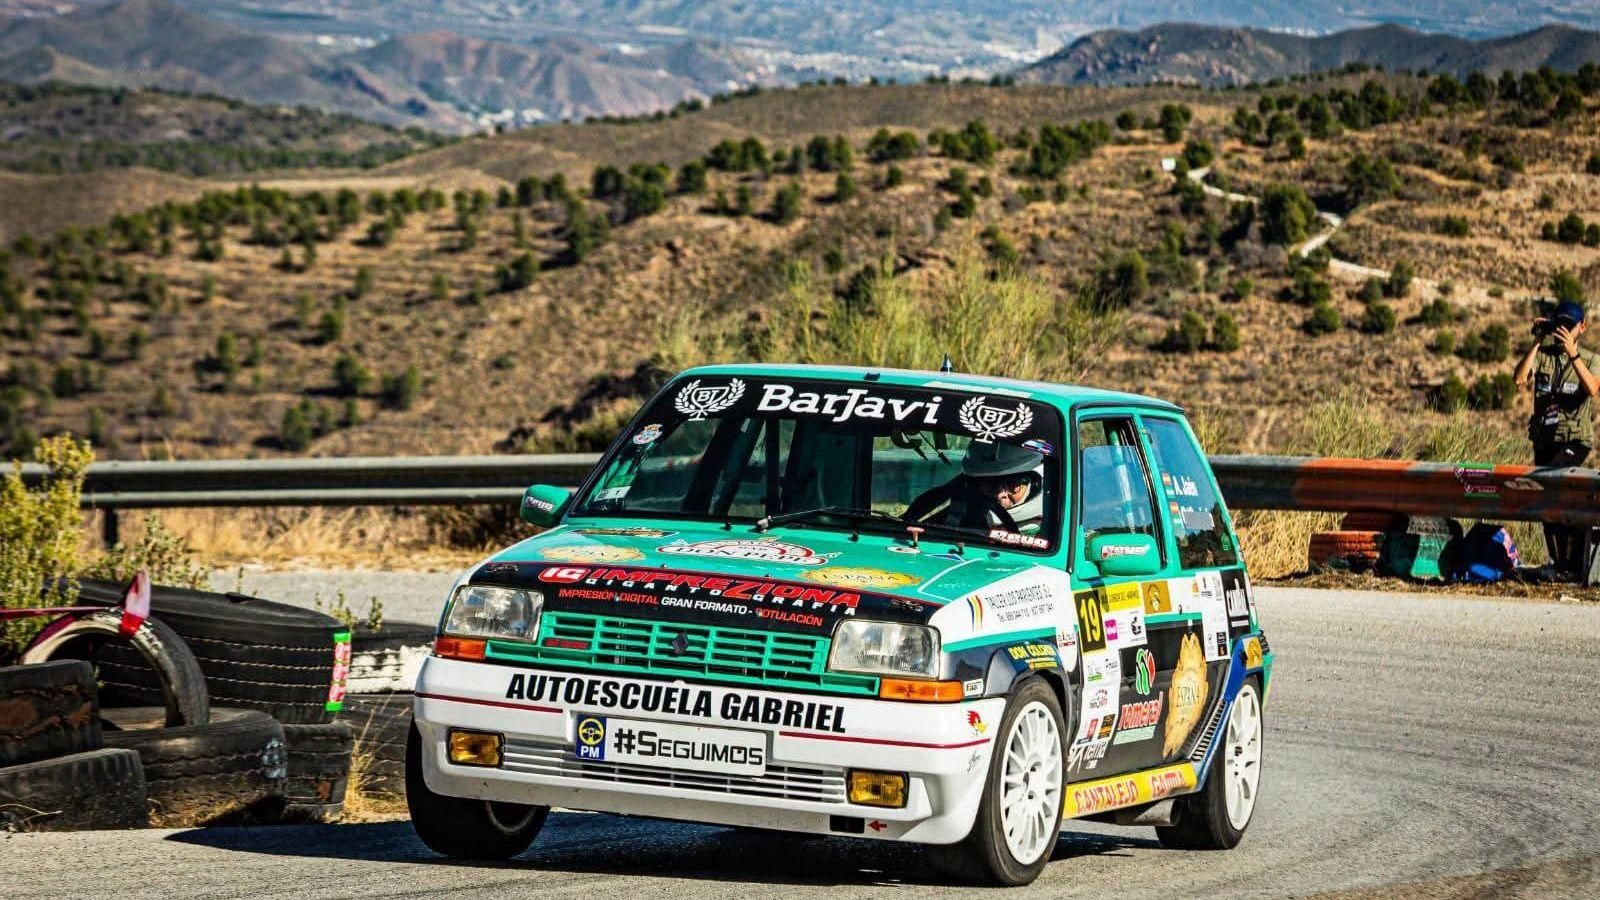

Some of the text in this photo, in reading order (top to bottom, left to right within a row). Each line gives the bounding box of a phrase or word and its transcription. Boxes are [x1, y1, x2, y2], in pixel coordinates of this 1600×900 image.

[757, 383, 943, 425] BarJavi
[543, 567, 586, 580] IG
[590, 568, 862, 608] IMPREZIONA
[618, 593, 659, 605] DIGITAL
[661, 596, 693, 609] GRAN
[694, 599, 748, 614] FORMATO
[1079, 597, 1101, 643] 19
[505, 673, 846, 733] AUTOESCUELA GABRIEL
[580, 745, 600, 759] PM
[1074, 779, 1139, 813] CANTALEJO
